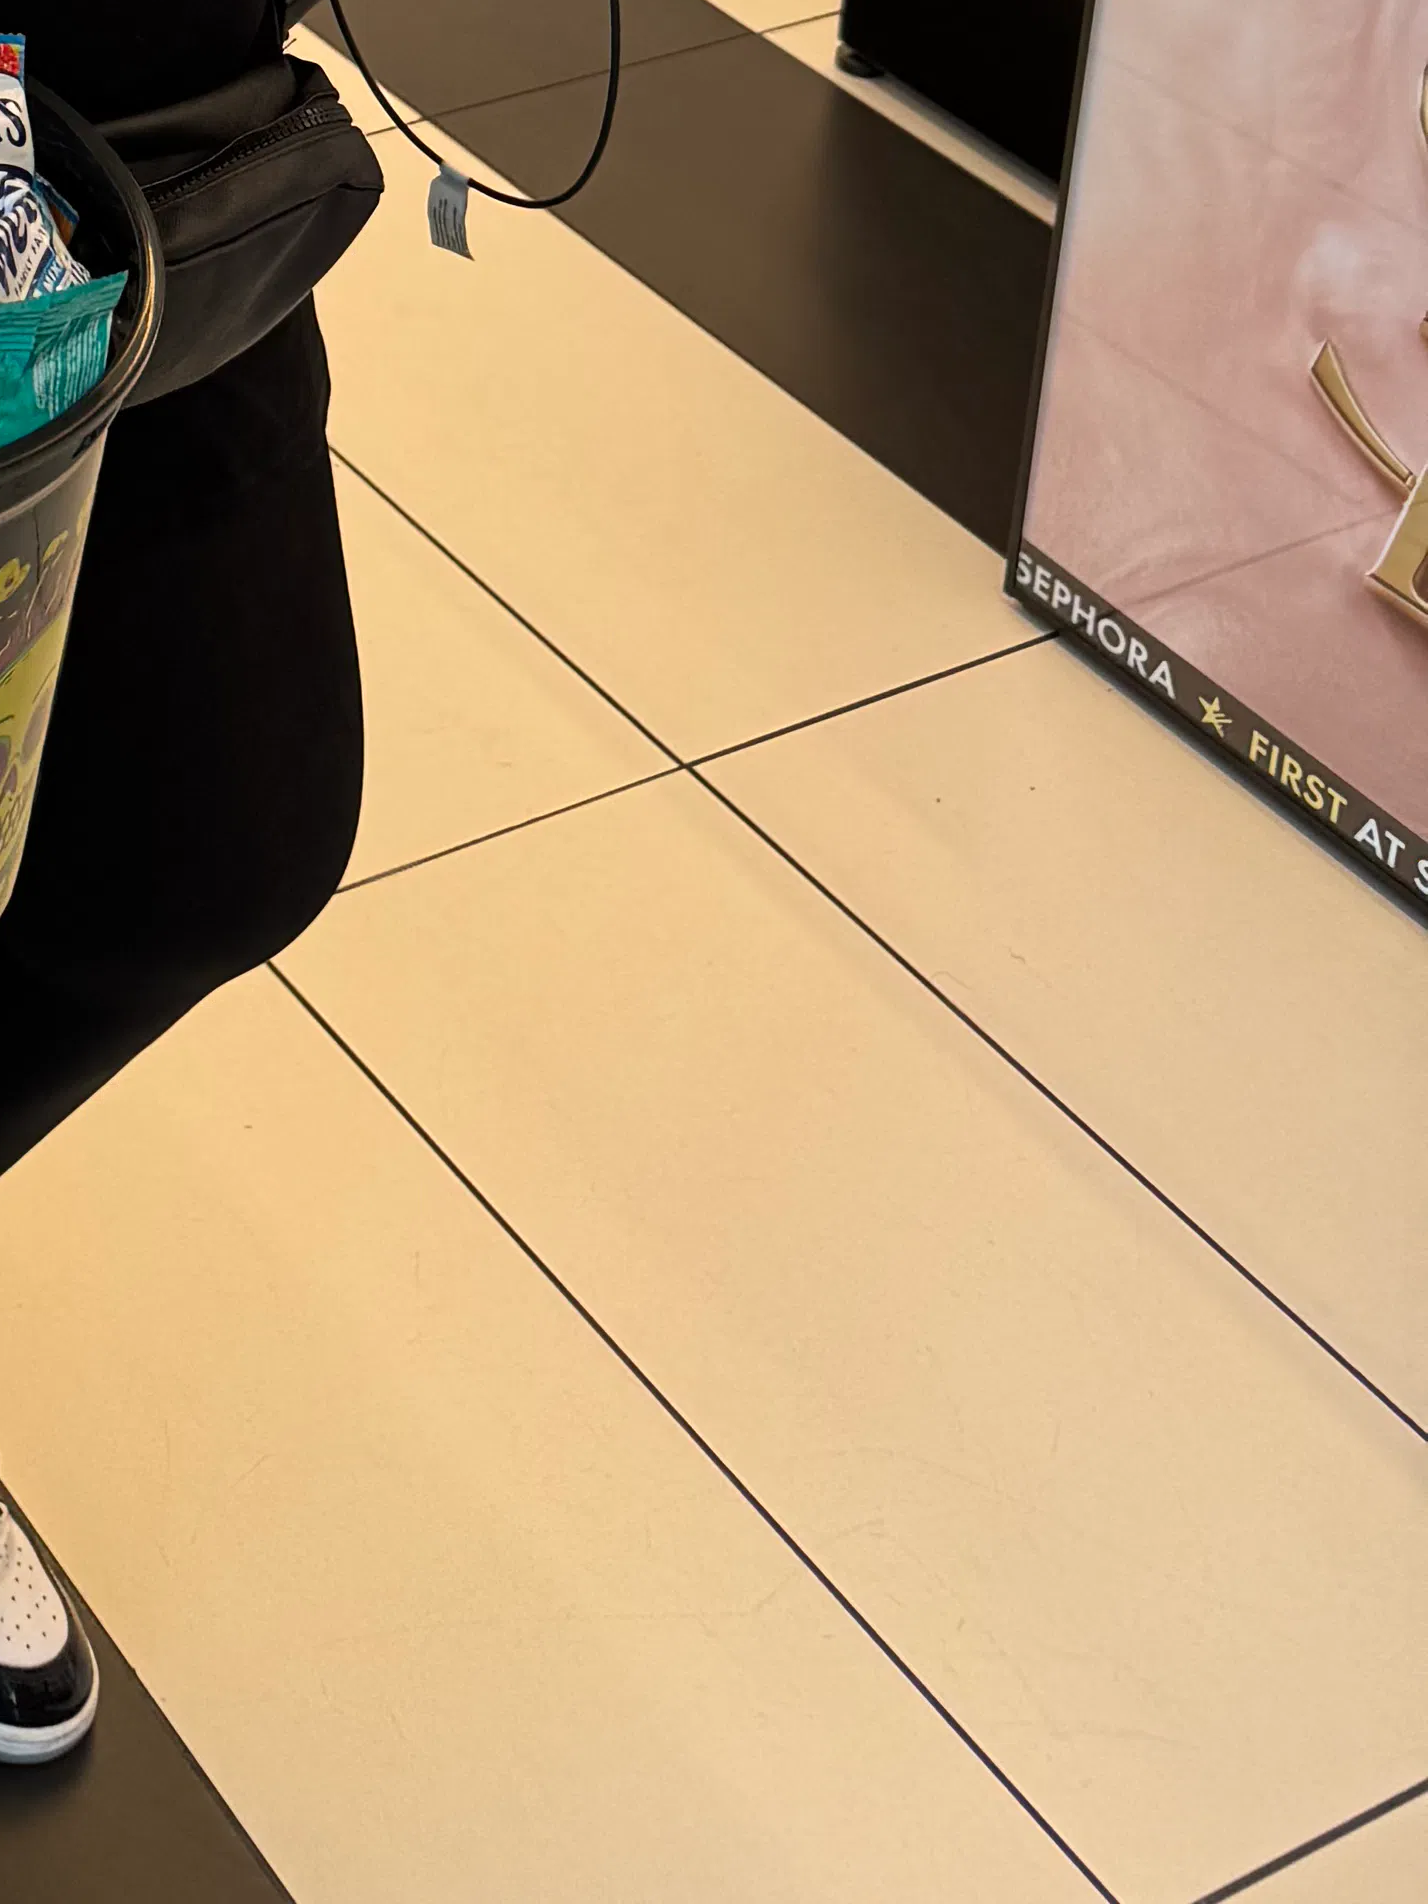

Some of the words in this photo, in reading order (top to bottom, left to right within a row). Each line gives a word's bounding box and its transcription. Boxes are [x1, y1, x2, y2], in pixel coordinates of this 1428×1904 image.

[1014, 553, 1178, 702] SEPHORA
[1249, 729, 1349, 828] FIRST
[1353, 818, 1407, 870] AT
